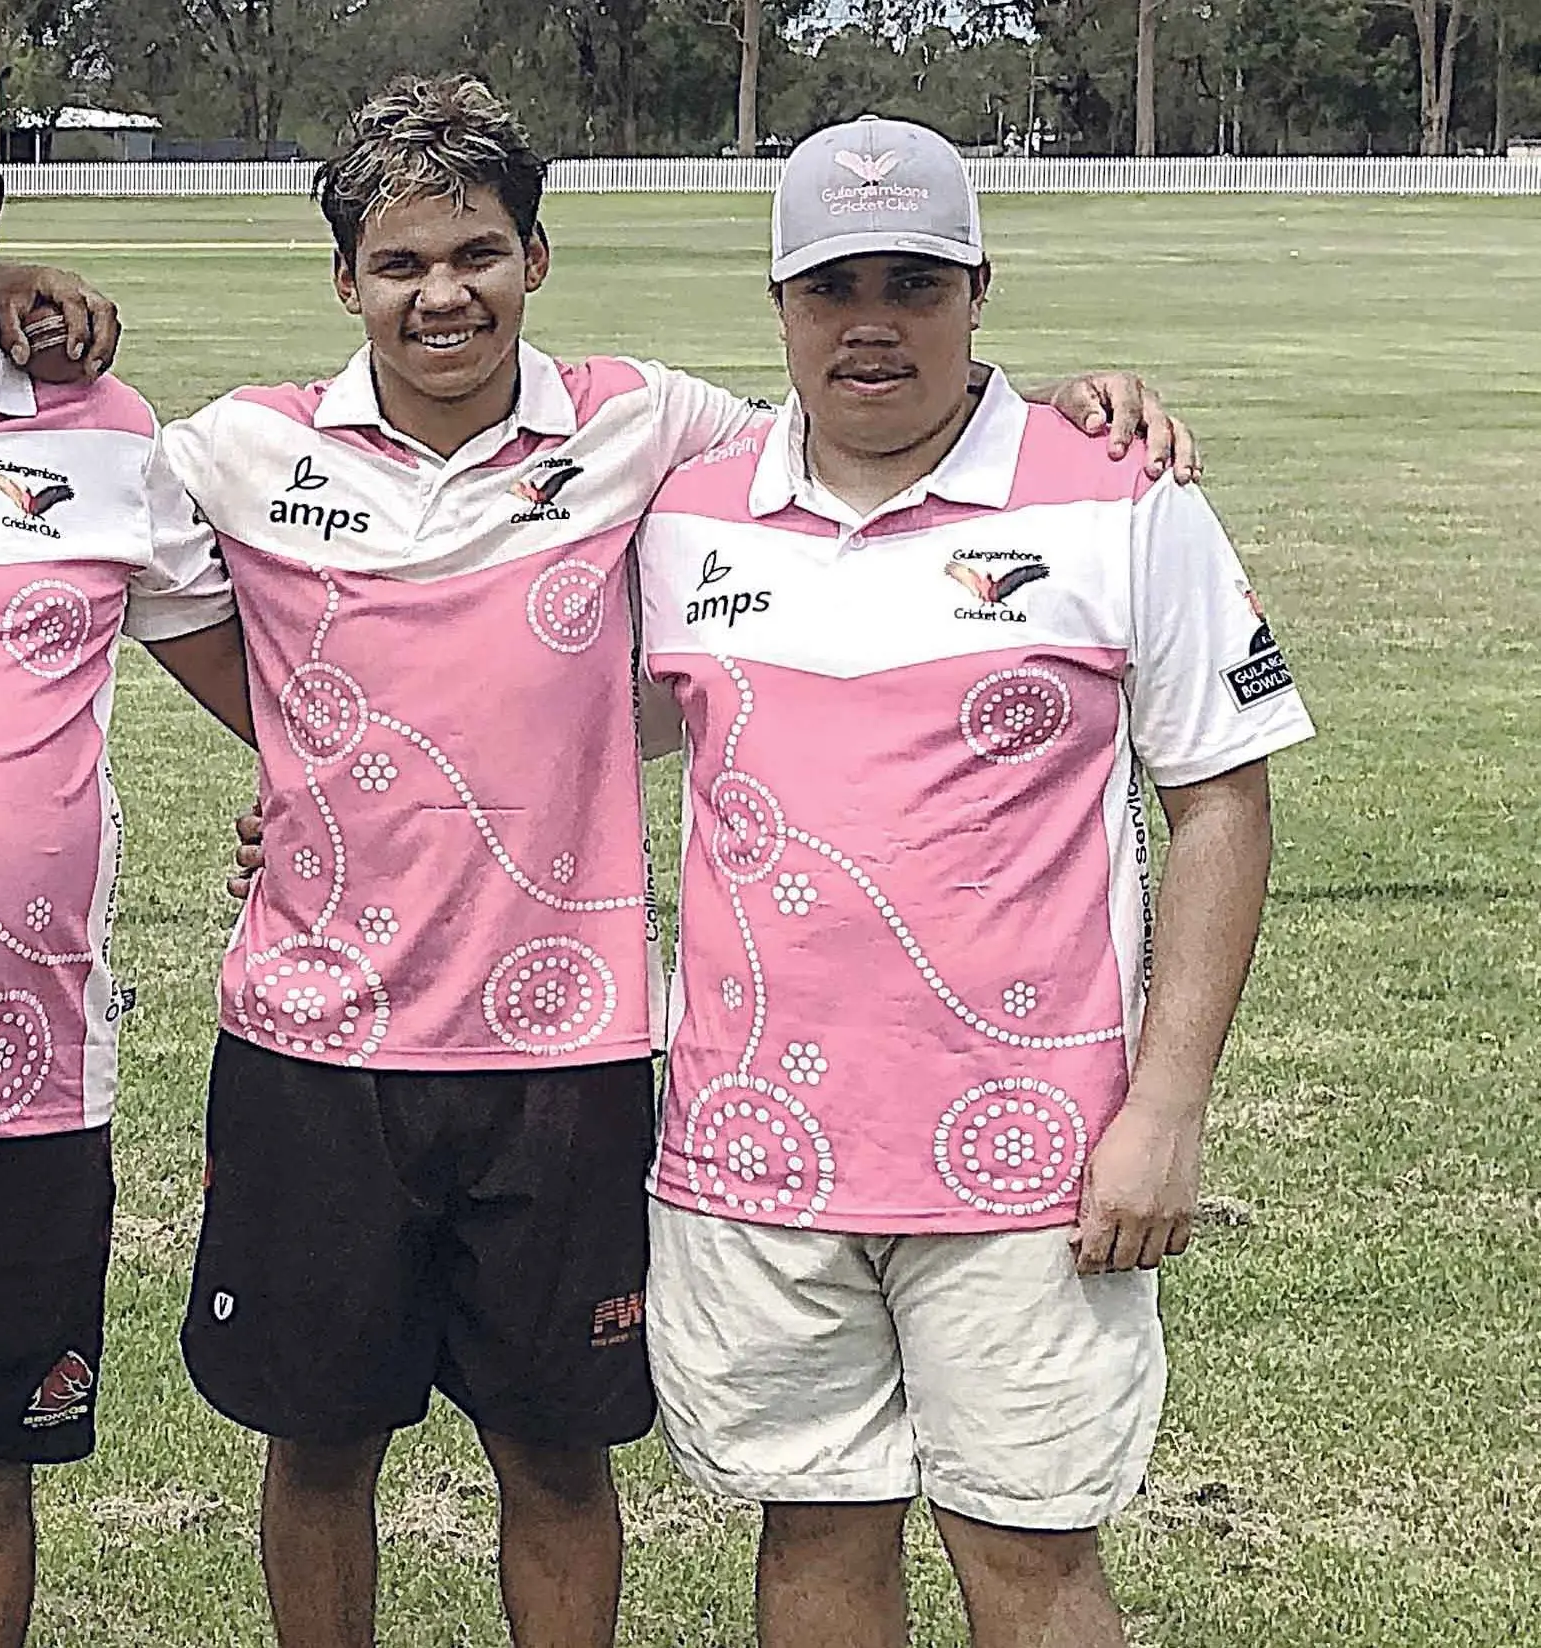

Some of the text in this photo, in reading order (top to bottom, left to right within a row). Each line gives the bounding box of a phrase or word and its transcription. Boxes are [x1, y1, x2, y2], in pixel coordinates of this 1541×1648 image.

[821, 182, 929, 203] Gulargambone
[829, 197, 919, 215] Cricket Club
[269, 499, 371, 542] amps
[952, 548, 1043, 562] Gulargambone
[686, 591, 772, 629] amps
[954, 607, 1027, 623] Cricket Club
